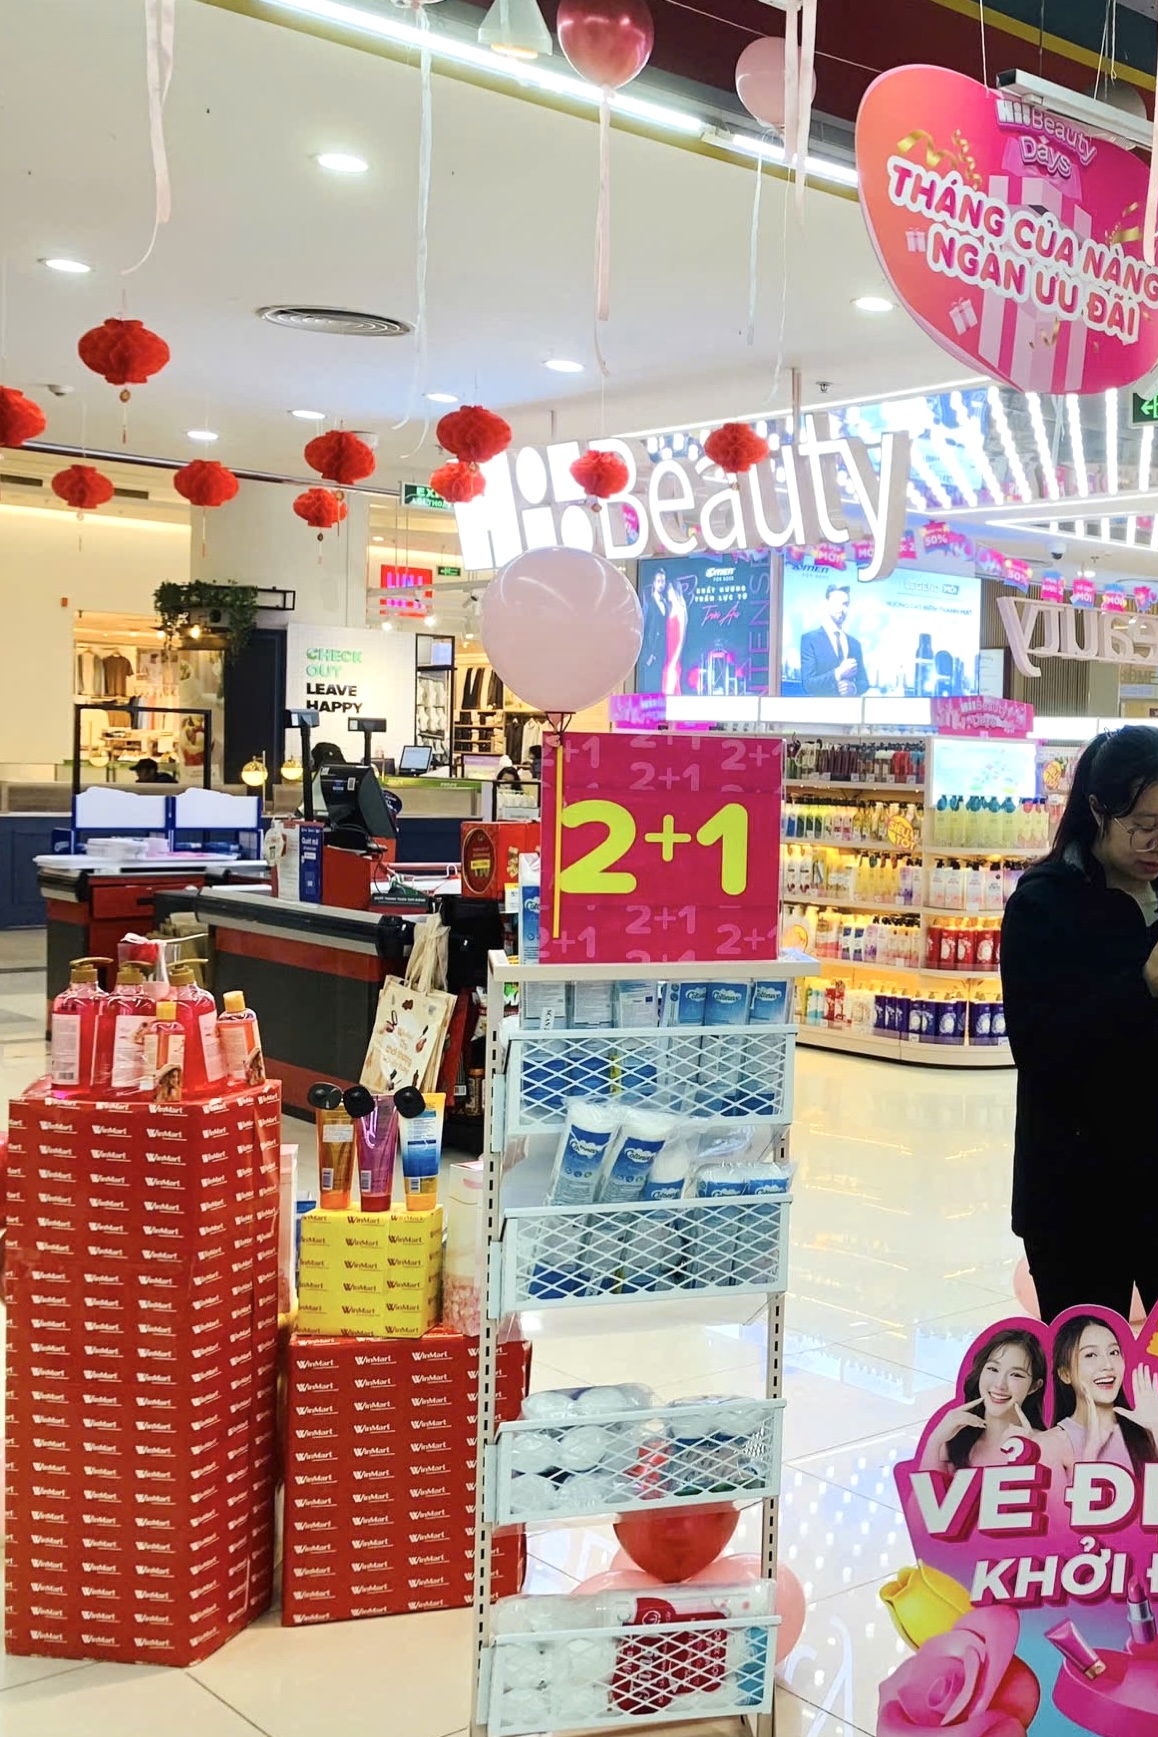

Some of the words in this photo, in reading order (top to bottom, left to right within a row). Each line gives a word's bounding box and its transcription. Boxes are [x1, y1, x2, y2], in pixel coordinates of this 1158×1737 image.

[1019, 135, 1072, 178] Days
[890, 163, 1008, 240] THÁNG
[1012, 212, 1077, 268] CỦA
[930, 235, 1028, 298] NGÀN
[1034, 271, 1080, 314] ƯU
[1085, 293, 1139, 340] ĐÃI
[306, 647, 363, 664] CHECK
[306, 664, 343, 679] OUT
[306, 683, 358, 698] LEAVE
[306, 700, 364, 714] HAPPY
[629, 762, 700, 791] 2+1
[560, 799, 748, 896] 2+1
[625, 904, 697, 935] 2+1
[909, 1437, 1038, 1535] VẺ
[970, 1536, 1128, 1601] KHỞI
